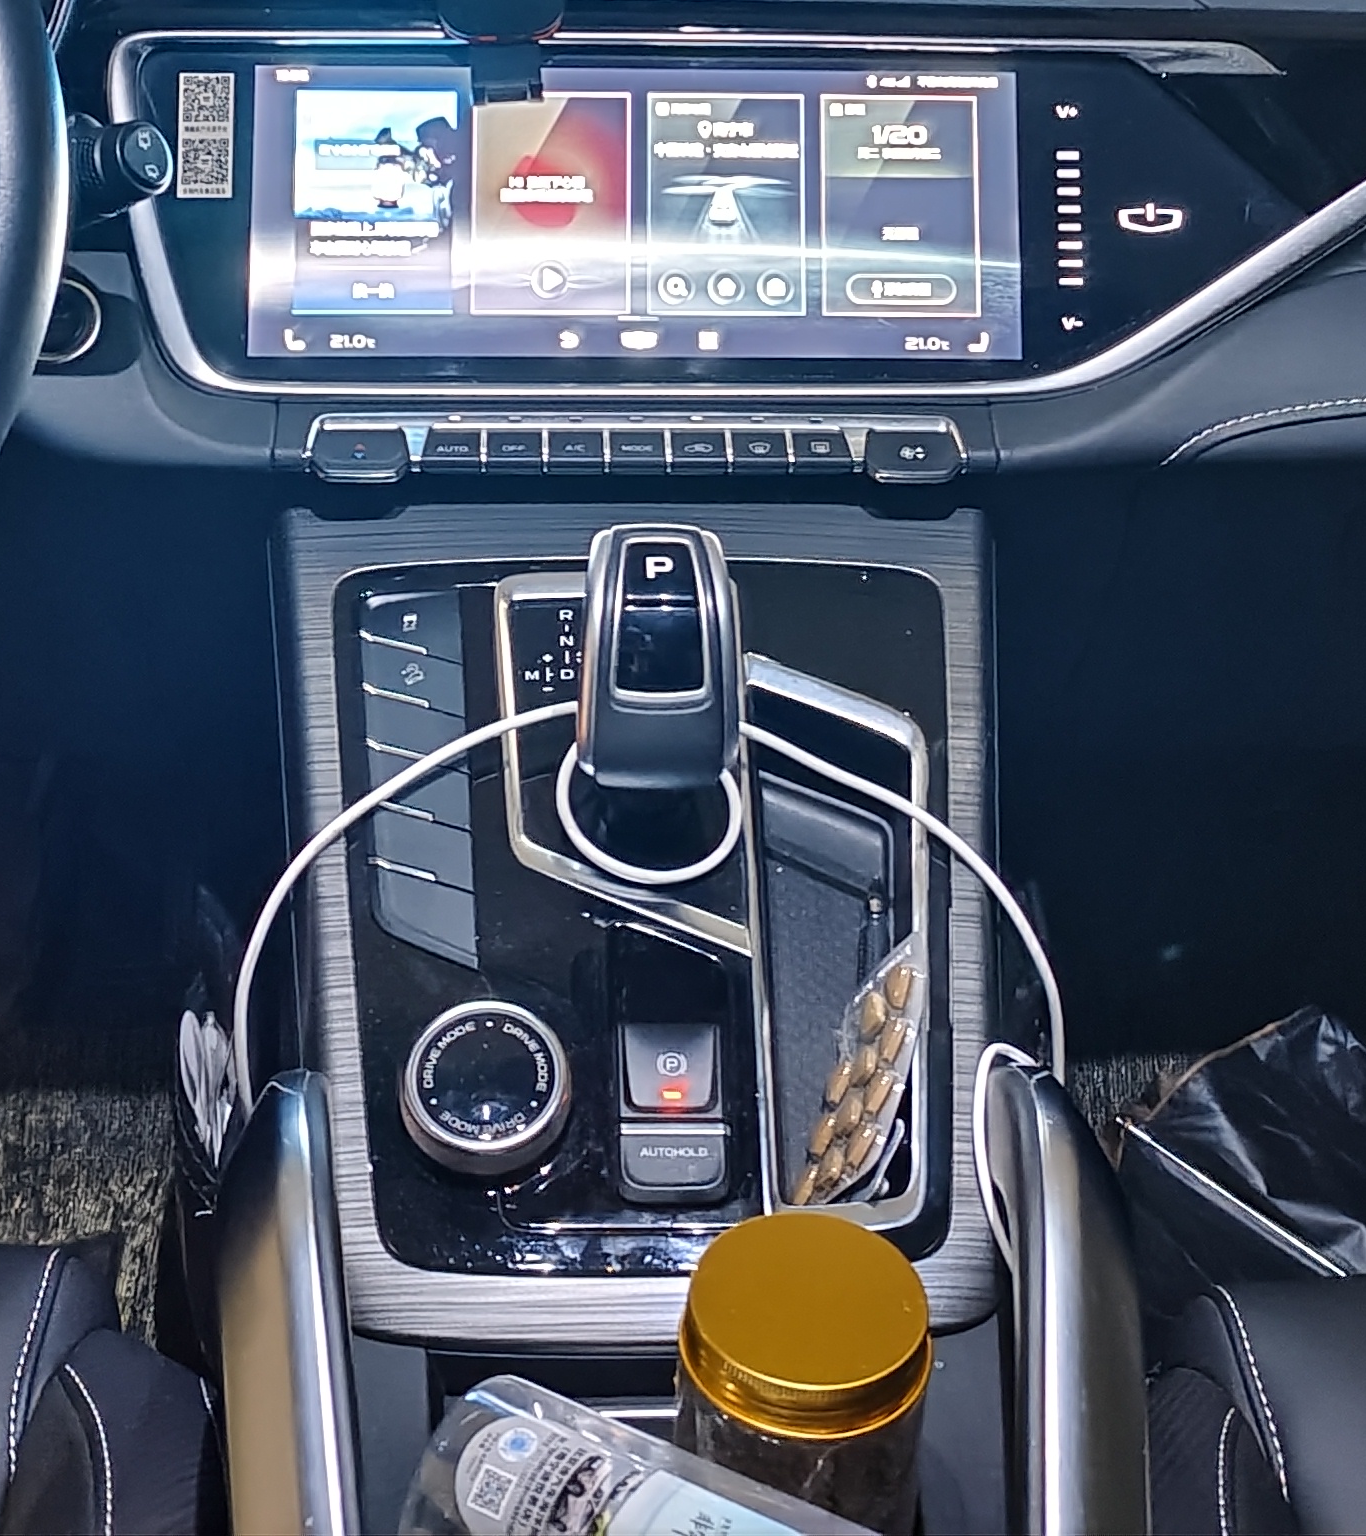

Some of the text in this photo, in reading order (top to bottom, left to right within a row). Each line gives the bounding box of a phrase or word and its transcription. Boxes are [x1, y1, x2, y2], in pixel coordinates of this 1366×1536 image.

[871, 124, 928, 146] 1/20
[502, 444, 526, 452] OFF
[564, 444, 585, 452] A/C
[621, 444, 653, 452] MODE
[645, 556, 674, 579] P
[559, 609, 574, 621] R
[559, 635, 574, 646] N
[524, 670, 540, 681] M
[560, 669, 575, 680] D
[422, 1021, 477, 1089] DRIVE MODE
[502, 1023, 550, 1092] DRIVE MODE
[438, 1110, 527, 1135] DRIVE MODE
[639, 1146, 709, 1157] AUTOHOLD
